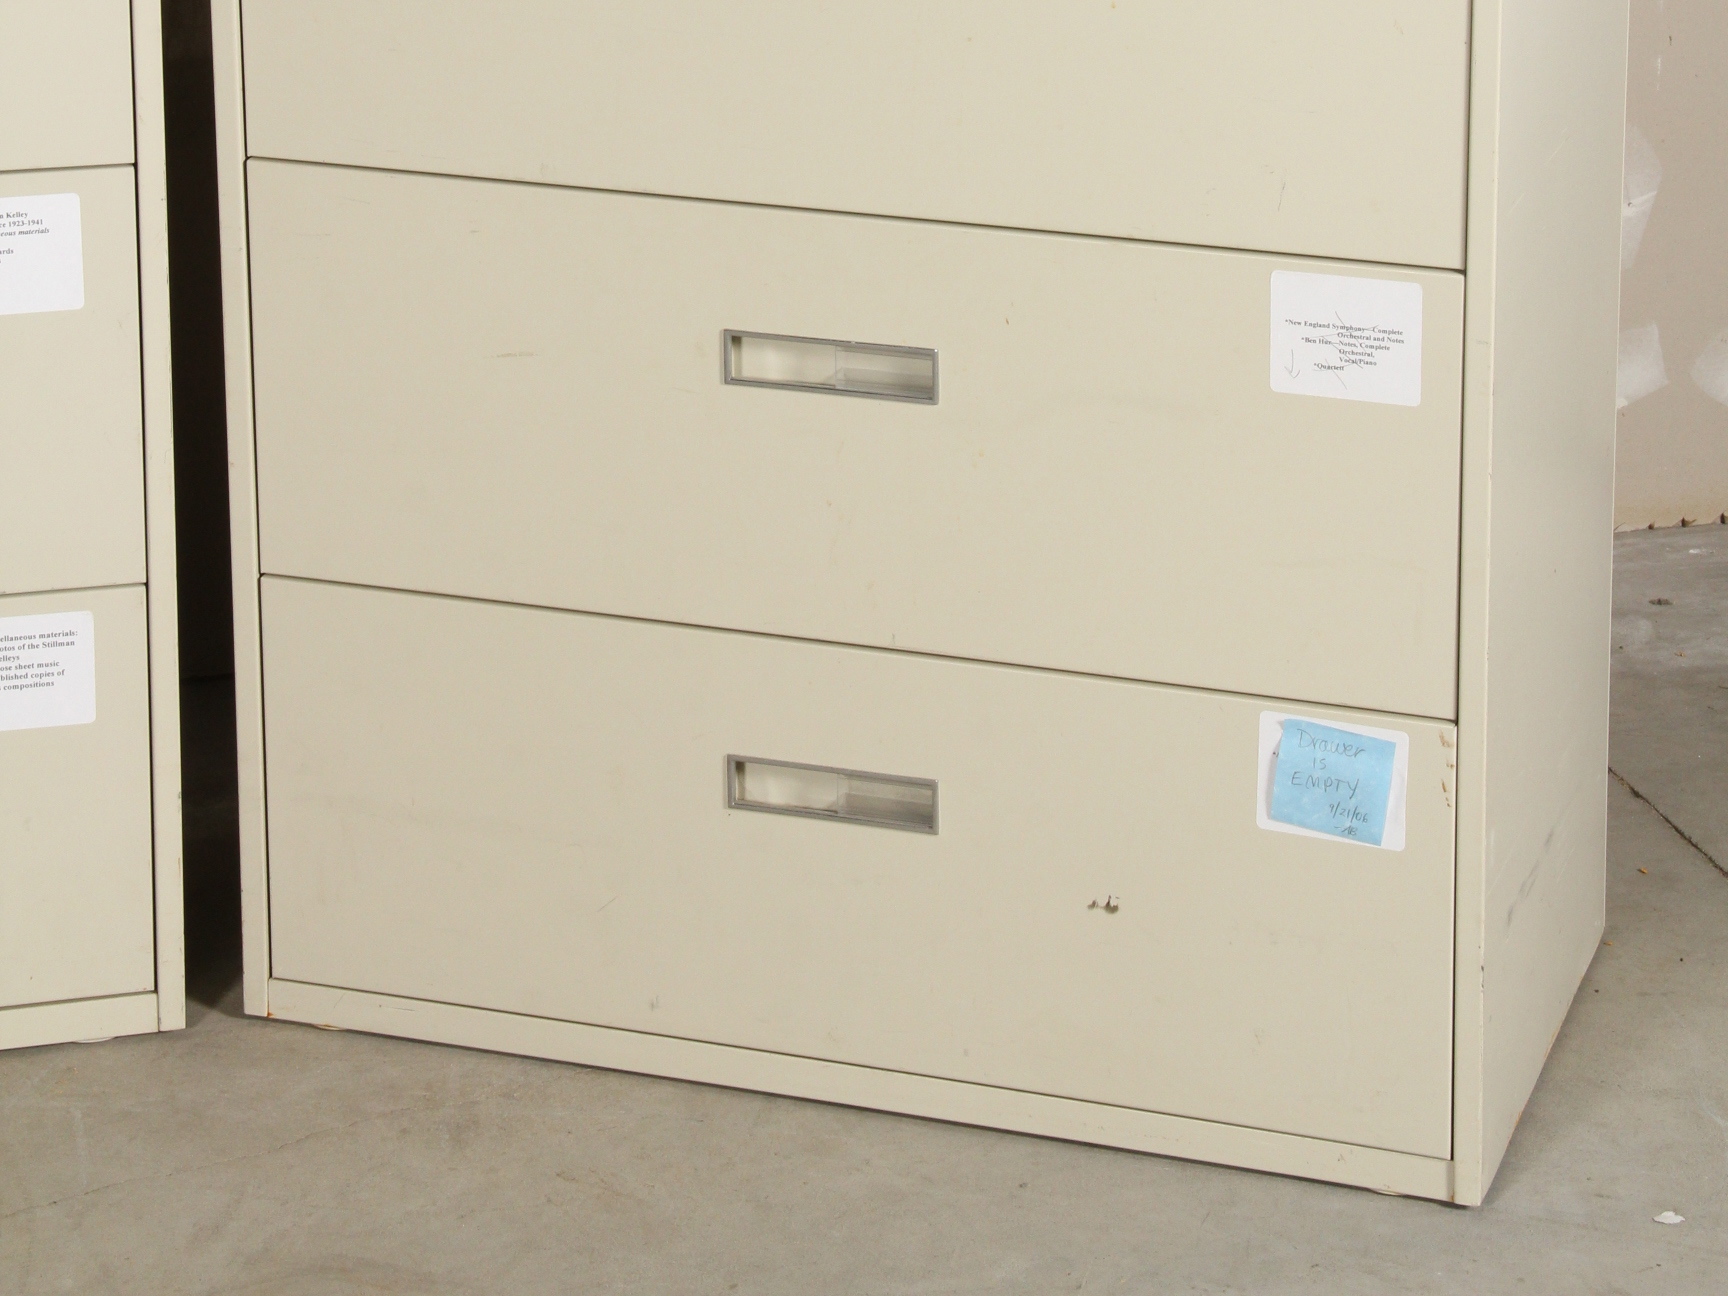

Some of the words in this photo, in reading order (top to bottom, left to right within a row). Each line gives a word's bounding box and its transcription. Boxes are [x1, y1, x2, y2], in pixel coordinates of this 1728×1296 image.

[8, 219, 43, 227] 1923-1941
[1337, 332, 1371, 341] Orchestral
[1360, 343, 1390, 351] Complete
[1339, 348, 1375, 357] Orchestral,
[39, 630, 78, 638] materials:
[42, 640, 75, 648] Stillman
[31, 671, 54, 679] copies
[3, 681, 54, 690] compositions
[1297, 728, 1365, 758] Drawer
[1291, 771, 1360, 799] EMPTY
